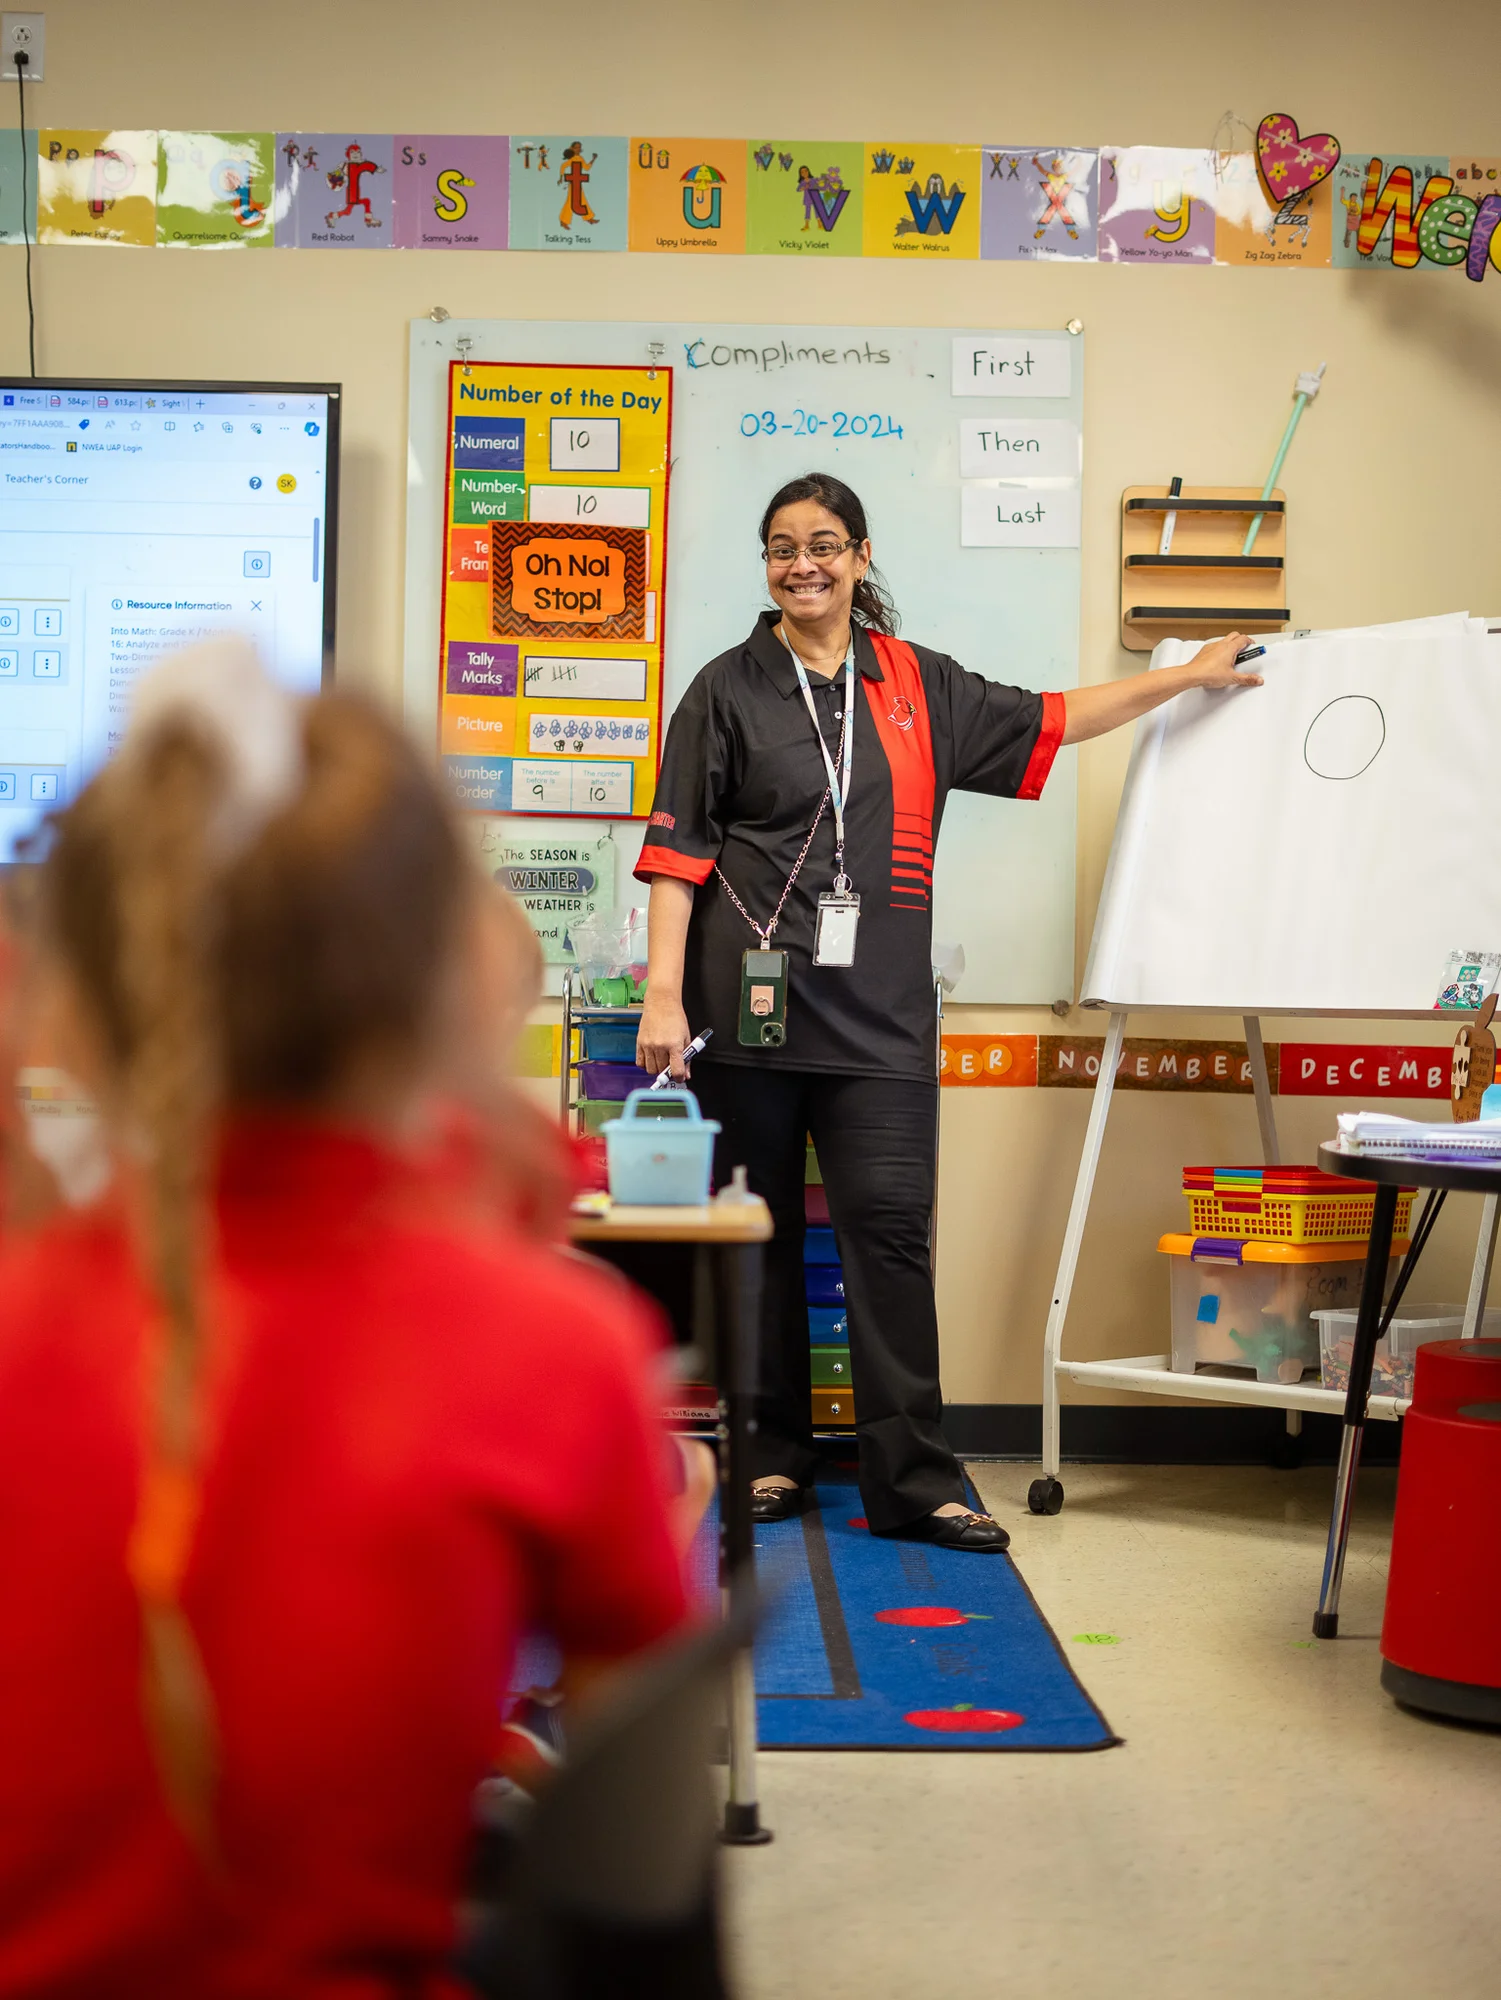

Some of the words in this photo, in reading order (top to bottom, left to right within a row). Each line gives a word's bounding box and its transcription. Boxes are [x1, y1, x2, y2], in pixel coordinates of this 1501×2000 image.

[1357, 157, 1501, 282] Wel
[311, 232, 328, 242] Red
[329, 233, 355, 242] Robot
[422, 234, 452, 244] Sammy
[454, 234, 479, 243] Snake
[544, 234, 573, 244] Talking
[574, 235, 592, 243] Tess
[656, 237, 678, 247] Uppy
[680, 238, 717, 247] Umbrella
[778, 240, 802, 250] Vicky
[803, 240, 830, 249] Violet
[892, 241, 920, 251] Walter
[921, 242, 950, 251] Walrus
[1120, 247, 1147, 257] Yellow
[1174, 250, 1193, 258] Man
[1245, 250, 1257, 261] Zig
[1259, 251, 1275, 261] Zag
[1277, 251, 1302, 260] Zebra
[684, 338, 891, 373] Compliments
[971, 351, 1036, 377] First
[162, 399, 181, 408] Sight
[459, 383, 543, 404] Number
[550, 388, 572, 406] of
[581, 389, 615, 408] the
[622, 391, 662, 414] Day
[740, 408, 904, 440] 03-20-2024
[82, 443, 104, 451] NWEA
[123, 444, 143, 453] Login
[459, 434, 520, 450] Numeral
[569, 430, 591, 451] 10
[977, 432, 1040, 453] Then
[5, 473, 53, 485] Teacher's
[54, 474, 89, 485] Corner
[280, 478, 293, 488] SK
[461, 478, 519, 494] Number
[471, 501, 507, 516] Word
[576, 494, 598, 516] 10
[997, 502, 1046, 524] Last
[474, 541, 489, 554] Te
[525, 553, 562, 576] Oh
[568, 554, 611, 578] No!
[127, 599, 173, 610] Resource
[174, 600, 232, 611] Information
[533, 587, 602, 616] Stop!
[110, 627, 129, 636] Into
[131, 627, 157, 636] Math:
[111, 640, 124, 648] 16:
[126, 640, 160, 650] Analyze
[467, 651, 495, 667] Tally
[461, 670, 504, 685] Marks
[457, 716, 504, 733] Picture
[448, 765, 504, 781] Number
[521, 768, 535, 776] The
[536, 769, 561, 777] number
[596, 770, 622, 778] number
[591, 778, 607, 786] after
[456, 785, 496, 800] Order
[532, 784, 544, 801] 9
[588, 786, 606, 802] 10
[648, 811, 676, 831] HARTER
[503, 848, 525, 861] The
[530, 849, 577, 861] SEASON
[581, 851, 590, 862] is
[509, 870, 579, 890] WINTER
[524, 899, 581, 911] WEATHER
[586, 901, 595, 911] is
[534, 927, 559, 938] and
